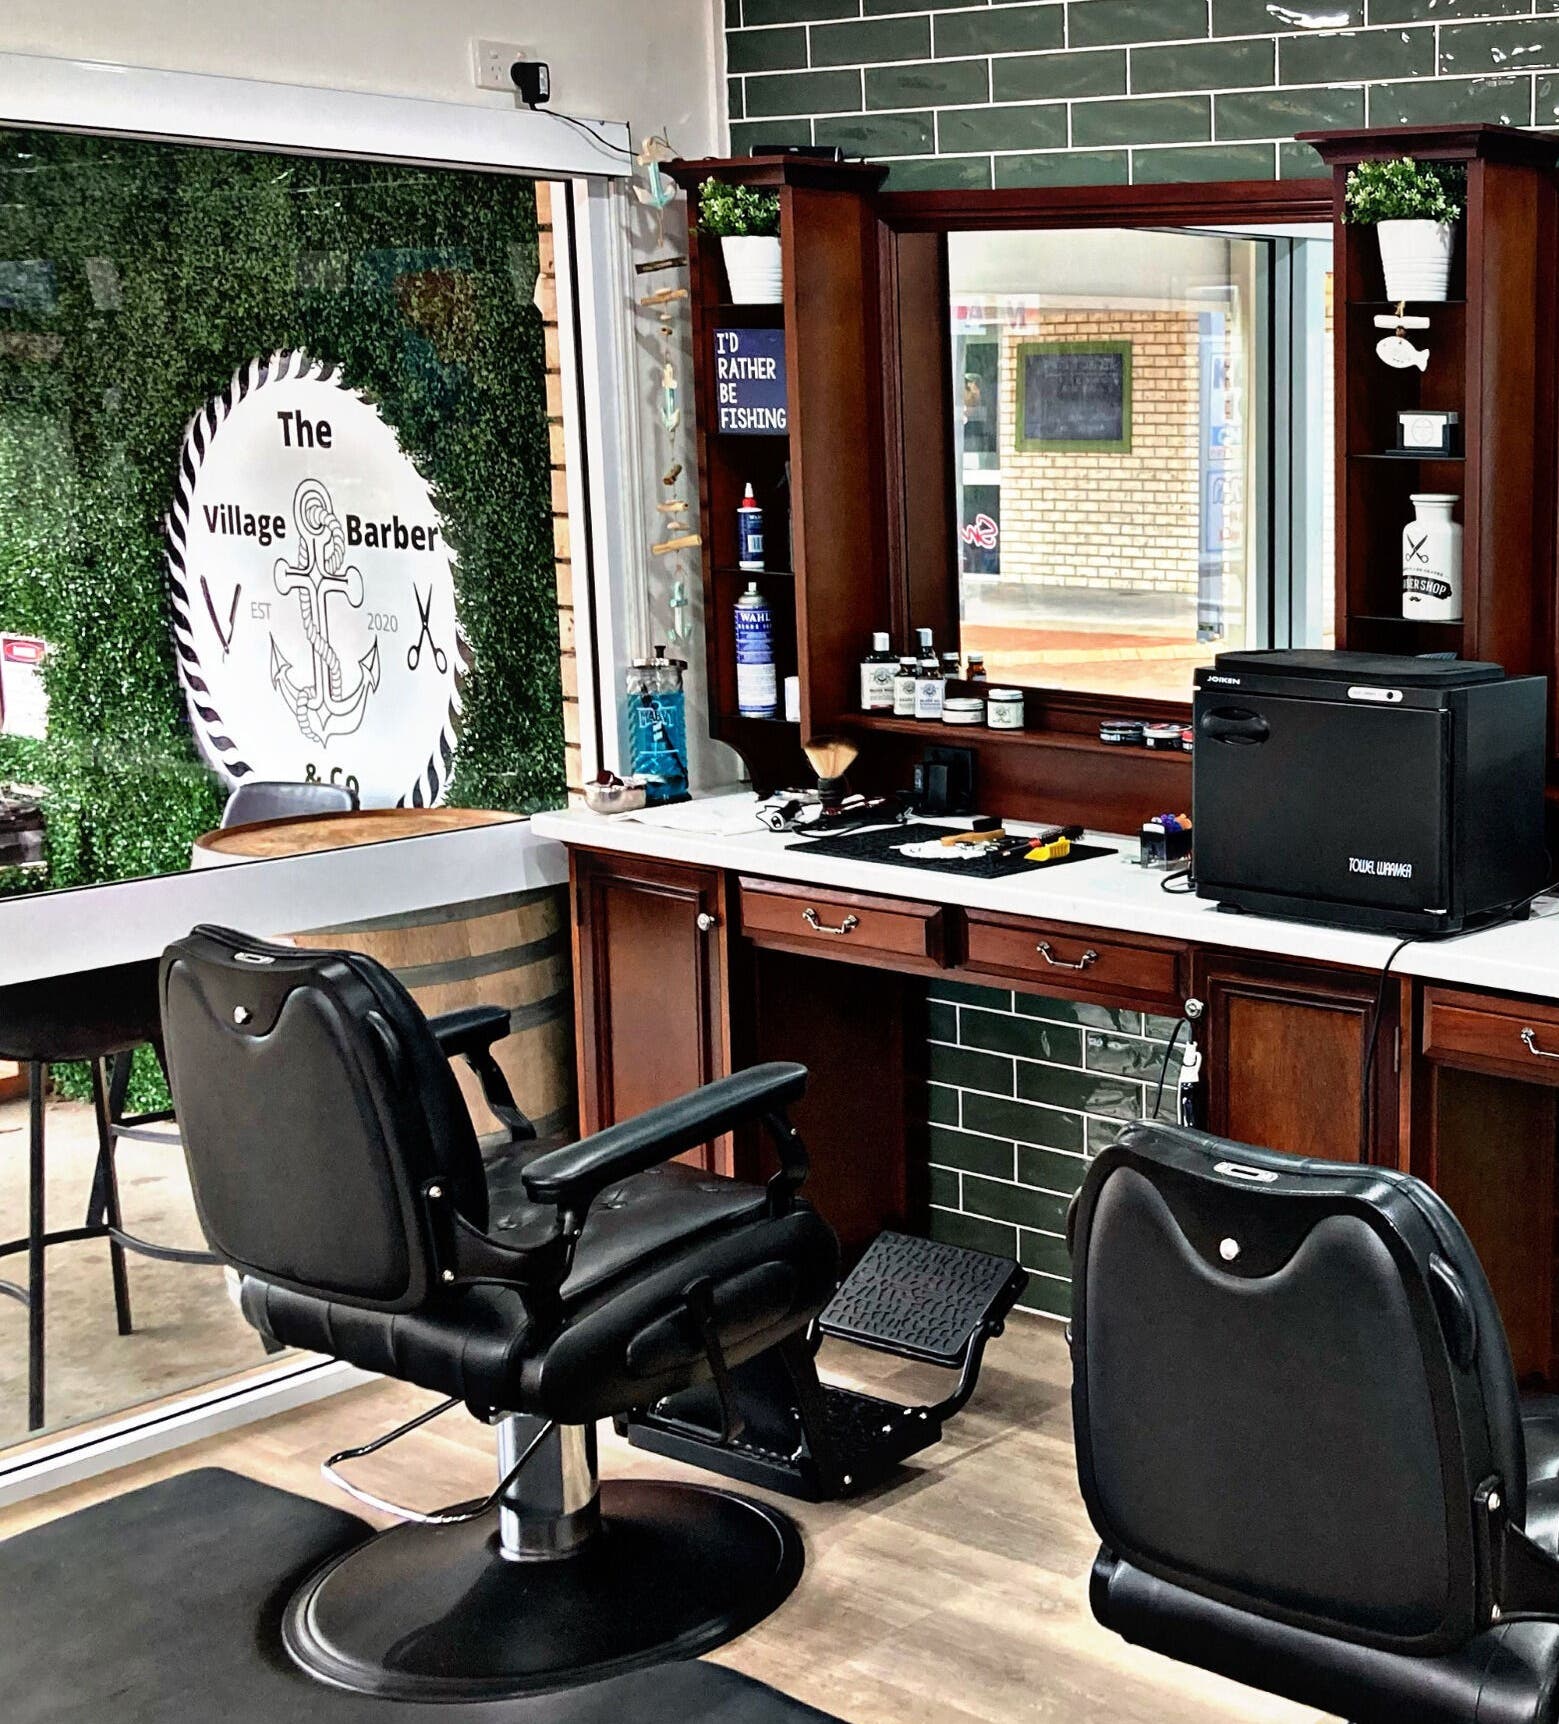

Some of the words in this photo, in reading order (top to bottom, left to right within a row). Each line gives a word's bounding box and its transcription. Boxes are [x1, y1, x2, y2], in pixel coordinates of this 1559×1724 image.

[716, 332, 739, 354] I'D
[717, 357, 776, 379] RATHER
[719, 383, 738, 404] BE
[720, 407, 787, 429] FISHING
[277, 409, 332, 449] The
[203, 503, 286, 547] Village
[346, 514, 439, 552] Barber
[1403, 577, 1447, 595] BERSHOP
[250, 601, 273, 620] EST
[740, 612, 771, 623] WAHL
[367, 612, 399, 633] 2020
[1206, 675, 1241, 686] JOIKEN
[1348, 857, 1376, 875] TOWEL
[1376, 861, 1413, 879] WARMER
